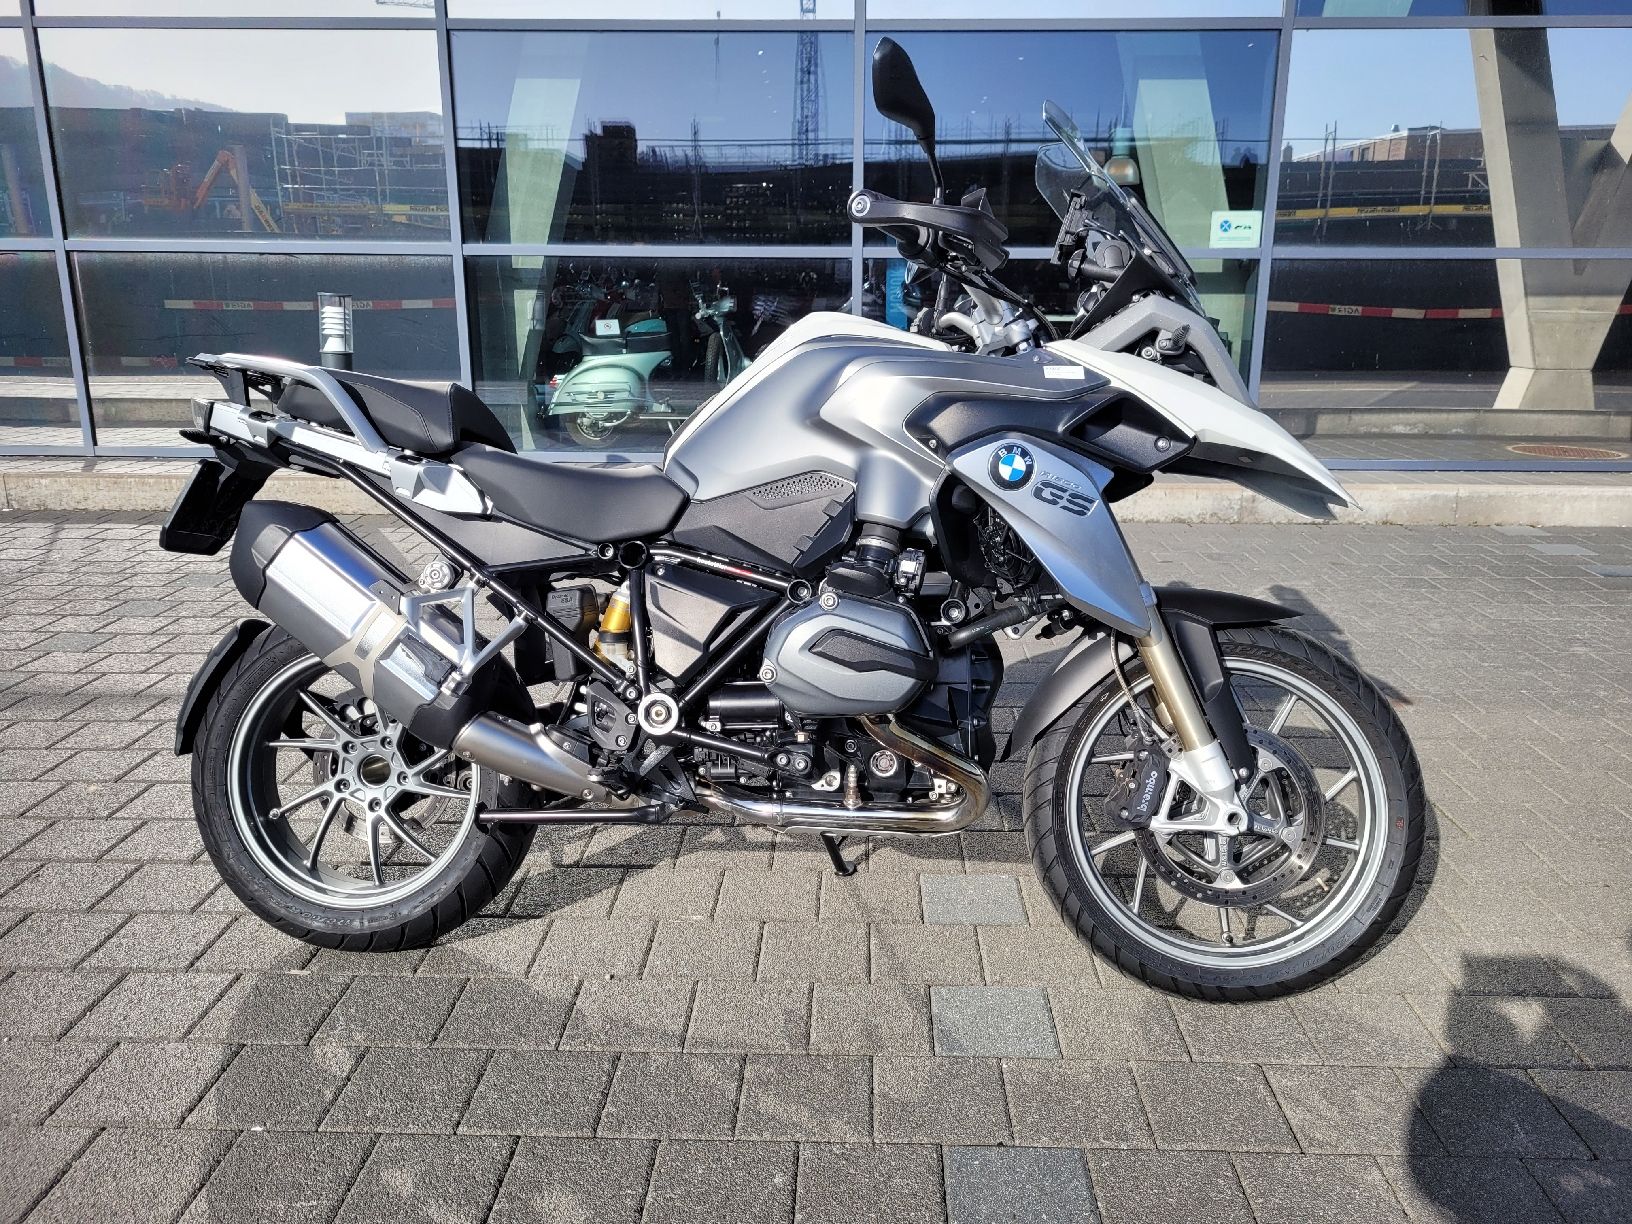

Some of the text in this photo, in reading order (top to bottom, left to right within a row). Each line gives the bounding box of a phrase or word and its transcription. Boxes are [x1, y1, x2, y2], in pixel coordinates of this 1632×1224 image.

[998, 446, 1033, 466] BMW
[1031, 480, 1099, 518] GS
[1136, 770, 1158, 812] brembo
